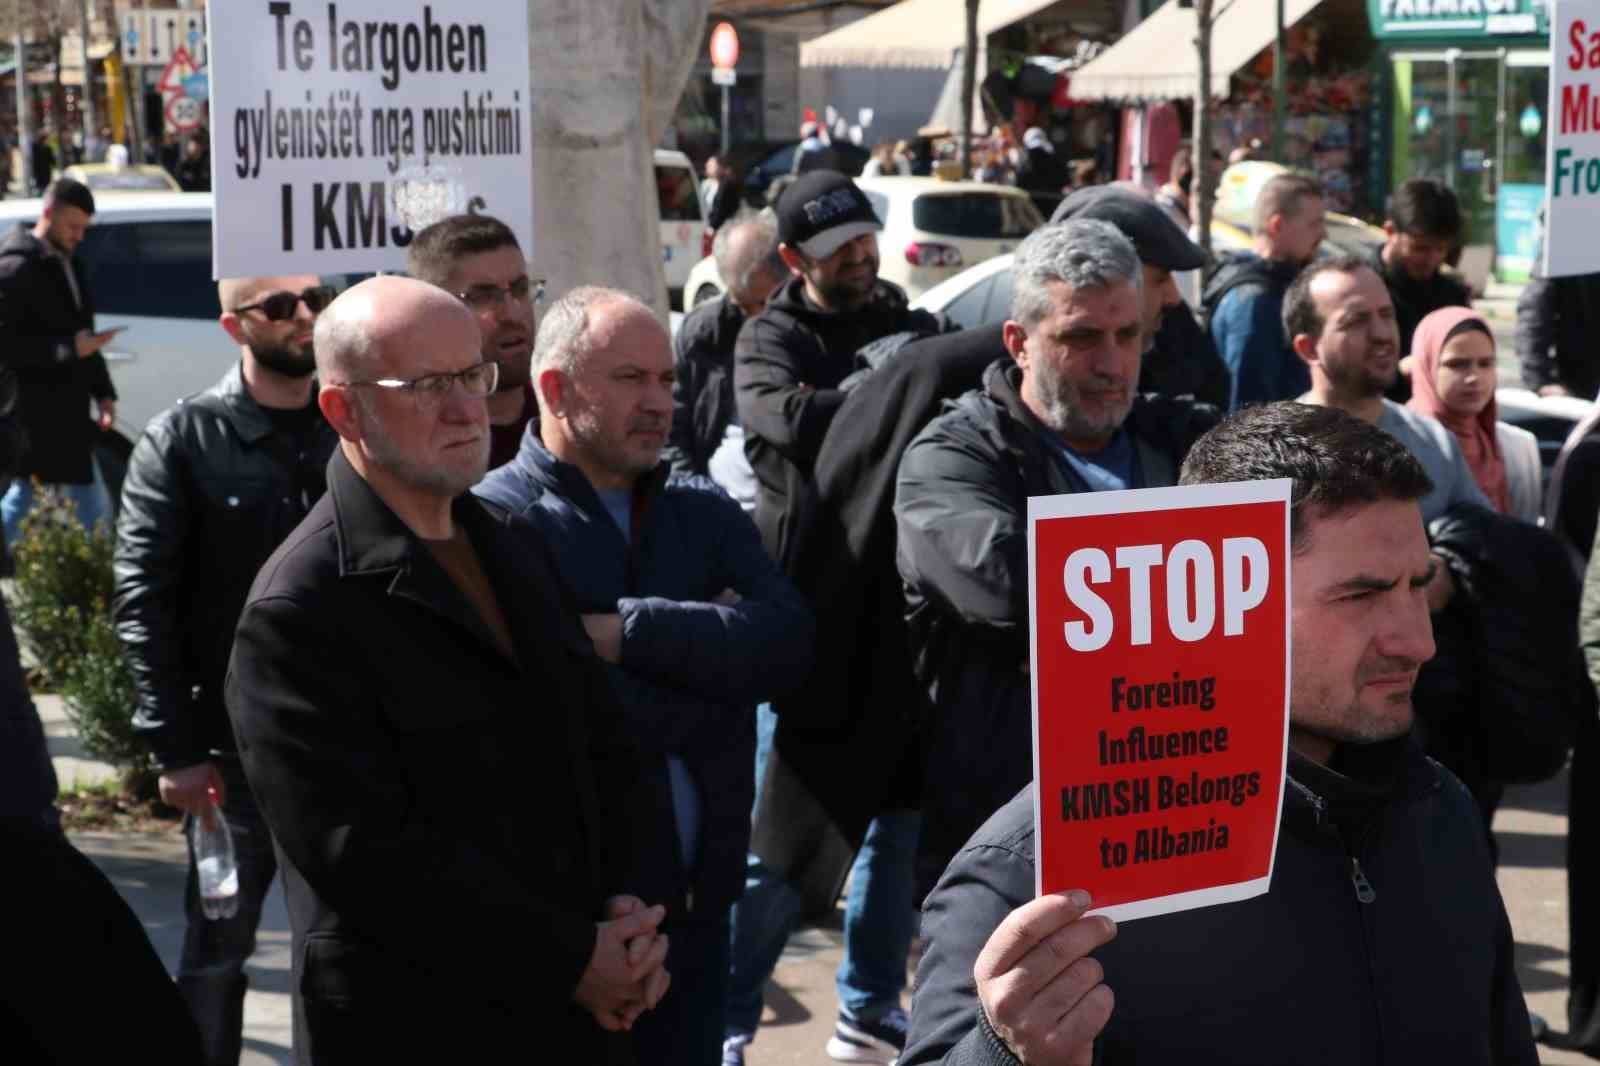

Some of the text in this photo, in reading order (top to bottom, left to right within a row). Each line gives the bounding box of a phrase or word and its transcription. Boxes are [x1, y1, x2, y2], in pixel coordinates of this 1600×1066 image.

[269, 1, 486, 91] Te largohen
[234, 89, 521, 179] gylenistët nga pushtimi
[282, 183, 293, 252] I
[1063, 536, 1270, 652] STOP
[1111, 672, 1216, 712] Foreing
[1097, 725, 1229, 766] Influence
[1060, 770, 1261, 822] KMSH Belongs
[1100, 818, 1229, 869] to Albania
